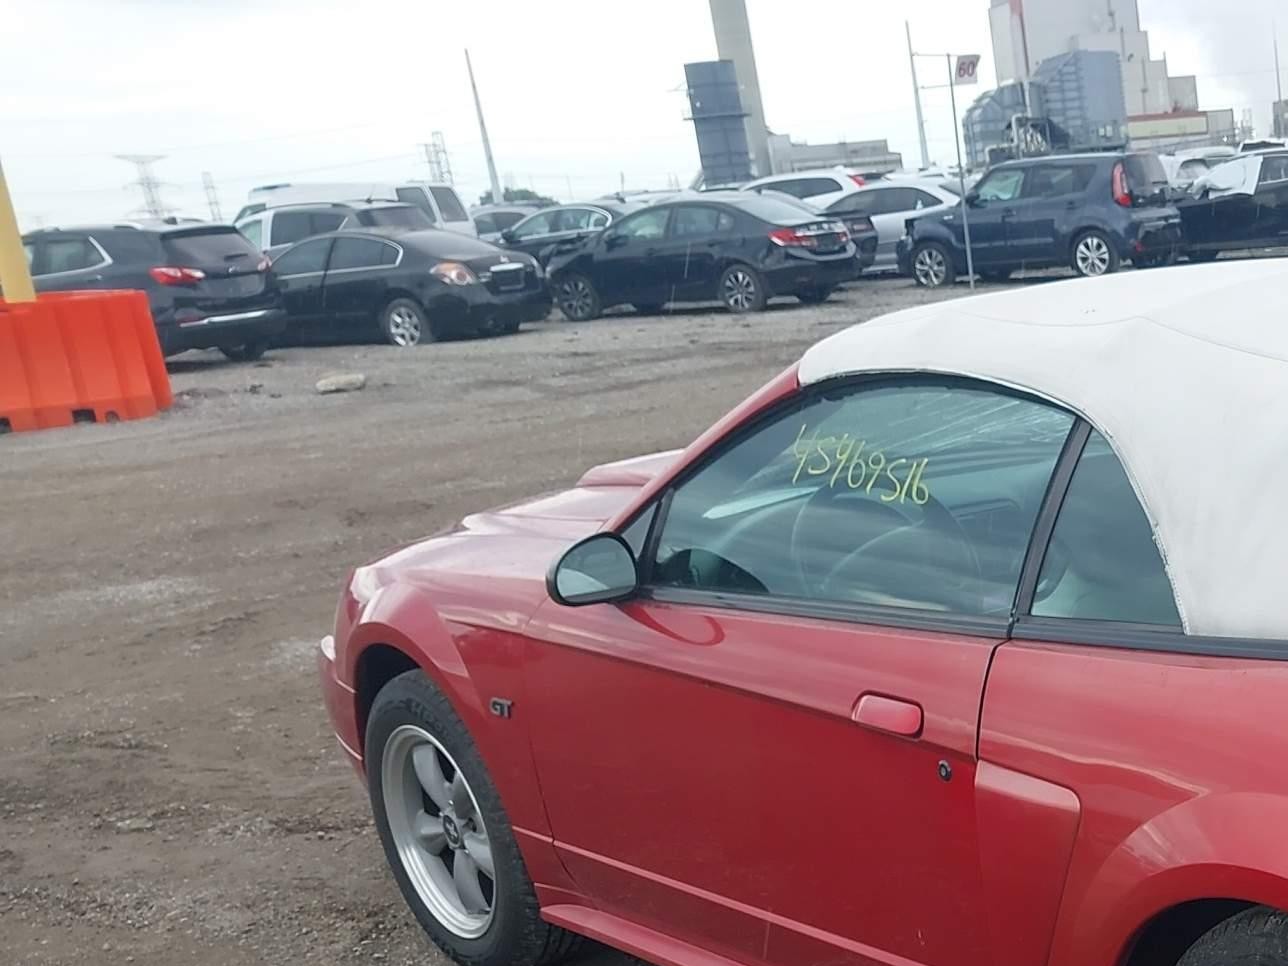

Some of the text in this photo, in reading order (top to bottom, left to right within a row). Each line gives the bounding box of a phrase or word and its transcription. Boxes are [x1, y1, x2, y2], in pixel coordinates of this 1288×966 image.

[958, 60, 976, 78] 60
[792, 424, 929, 504] 45469516
[489, 696, 513, 719] GT
